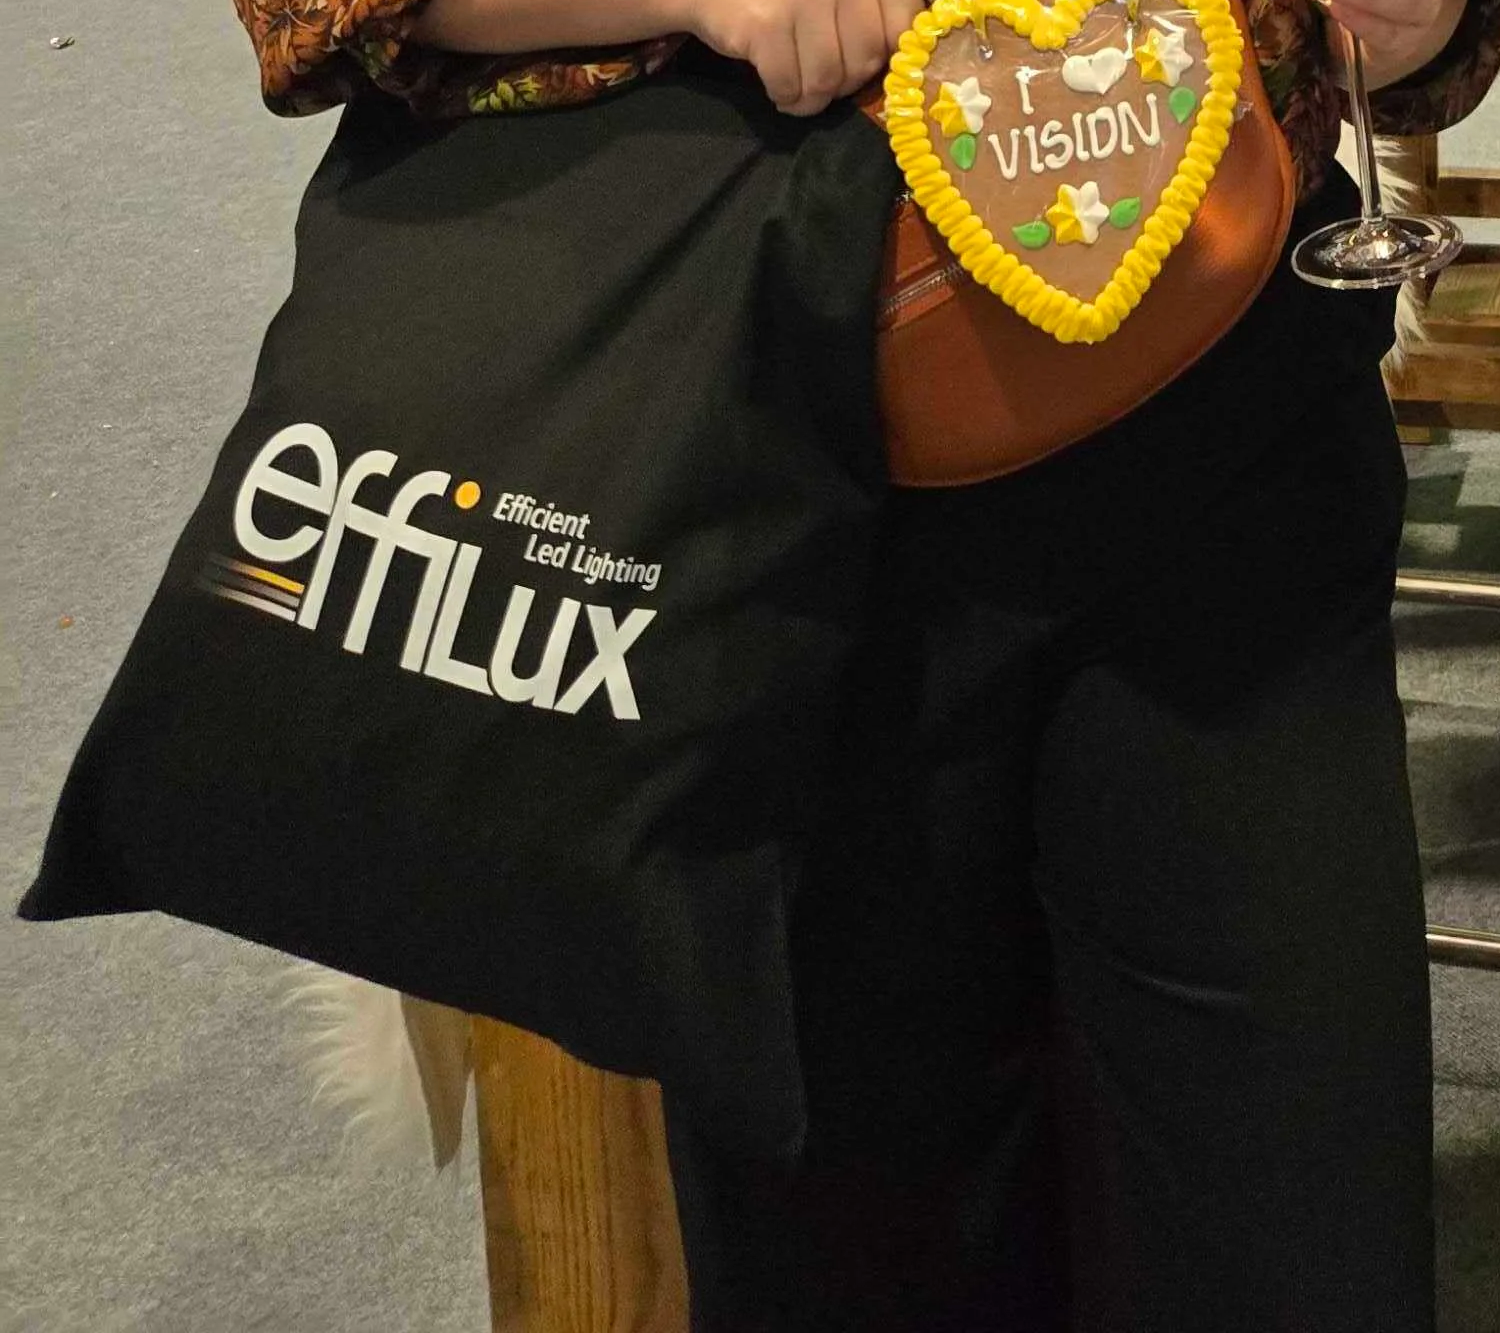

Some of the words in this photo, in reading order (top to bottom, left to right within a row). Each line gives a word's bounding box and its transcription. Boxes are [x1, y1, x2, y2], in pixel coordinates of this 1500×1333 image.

[987, 92, 1161, 180] VISION
[493, 491, 591, 541] Efficient
[524, 534, 570, 569] Led
[570, 543, 663, 591] Lighting
